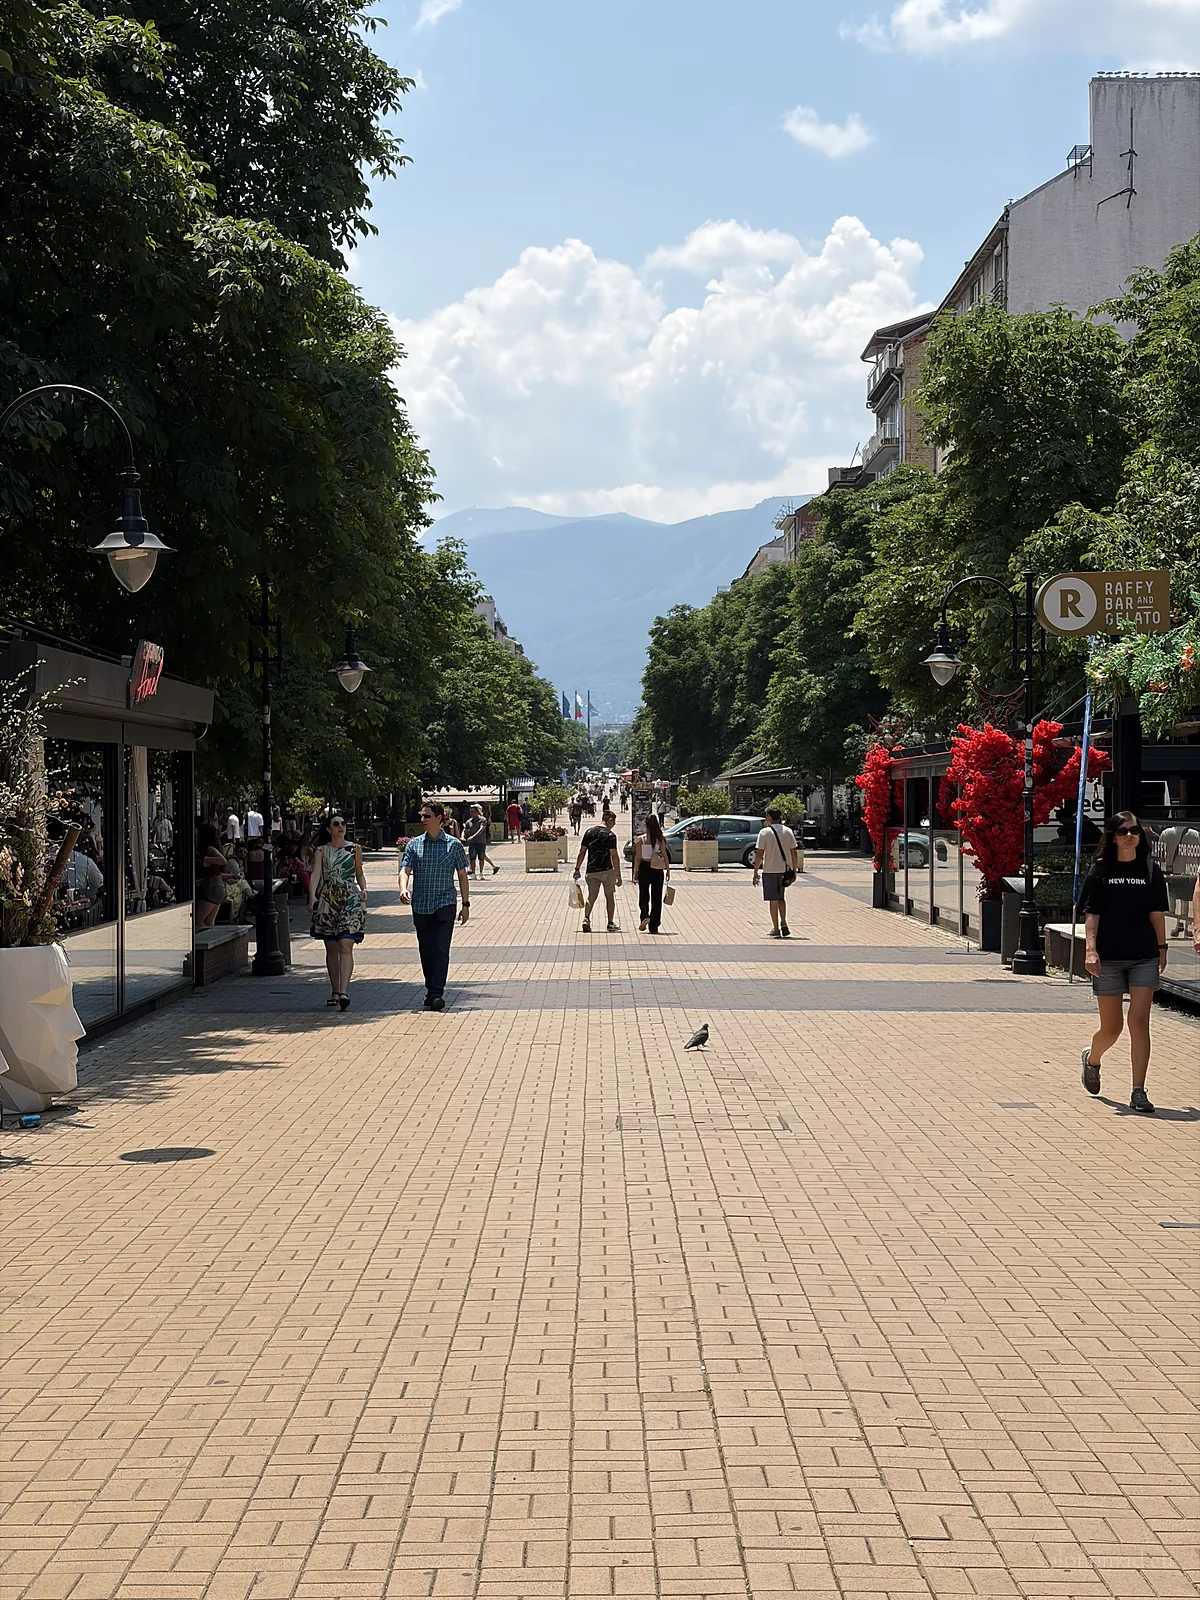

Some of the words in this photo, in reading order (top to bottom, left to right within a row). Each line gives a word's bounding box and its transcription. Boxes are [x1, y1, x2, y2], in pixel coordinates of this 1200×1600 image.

[1105, 581, 1154, 595] RAFFY
[1059, 588, 1085, 618] R
[1105, 597, 1134, 610] BAR
[1137, 596, 1154, 604] AND
